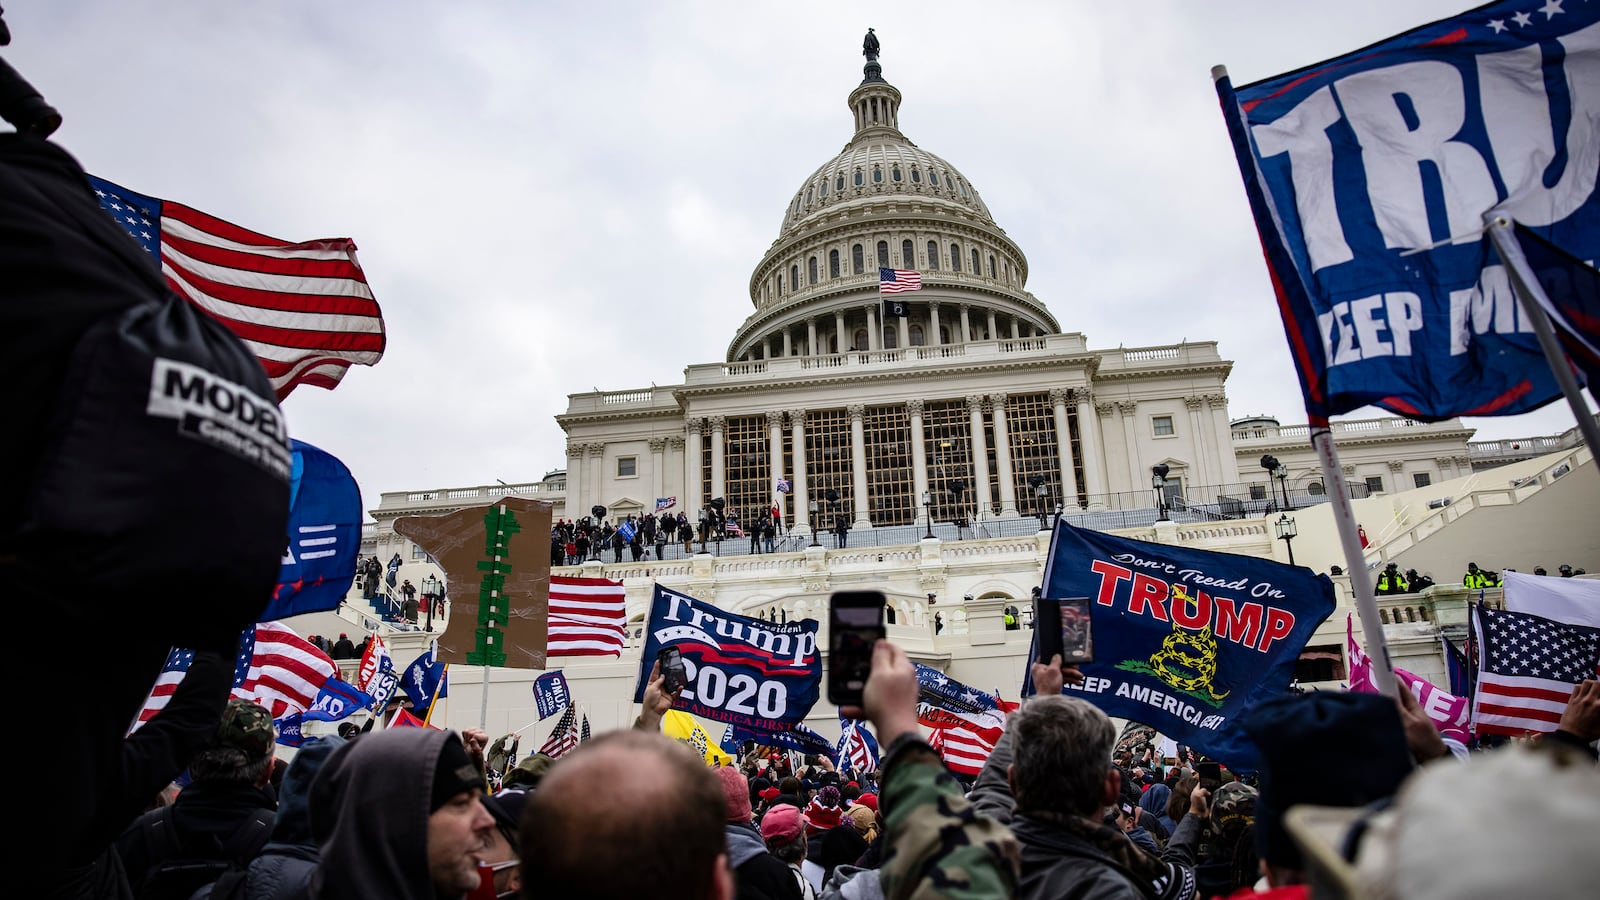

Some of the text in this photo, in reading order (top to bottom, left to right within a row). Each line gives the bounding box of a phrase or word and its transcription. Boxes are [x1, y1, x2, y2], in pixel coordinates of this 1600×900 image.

[1111, 553, 1285, 599] Don't Tread On
[660, 590, 815, 667] Trump
[1091, 559, 1296, 653] TRUMP
[691, 703, 752, 726] AMERICA
[755, 718, 796, 732] FIRST
[1115, 681, 1201, 727] AMERICA
